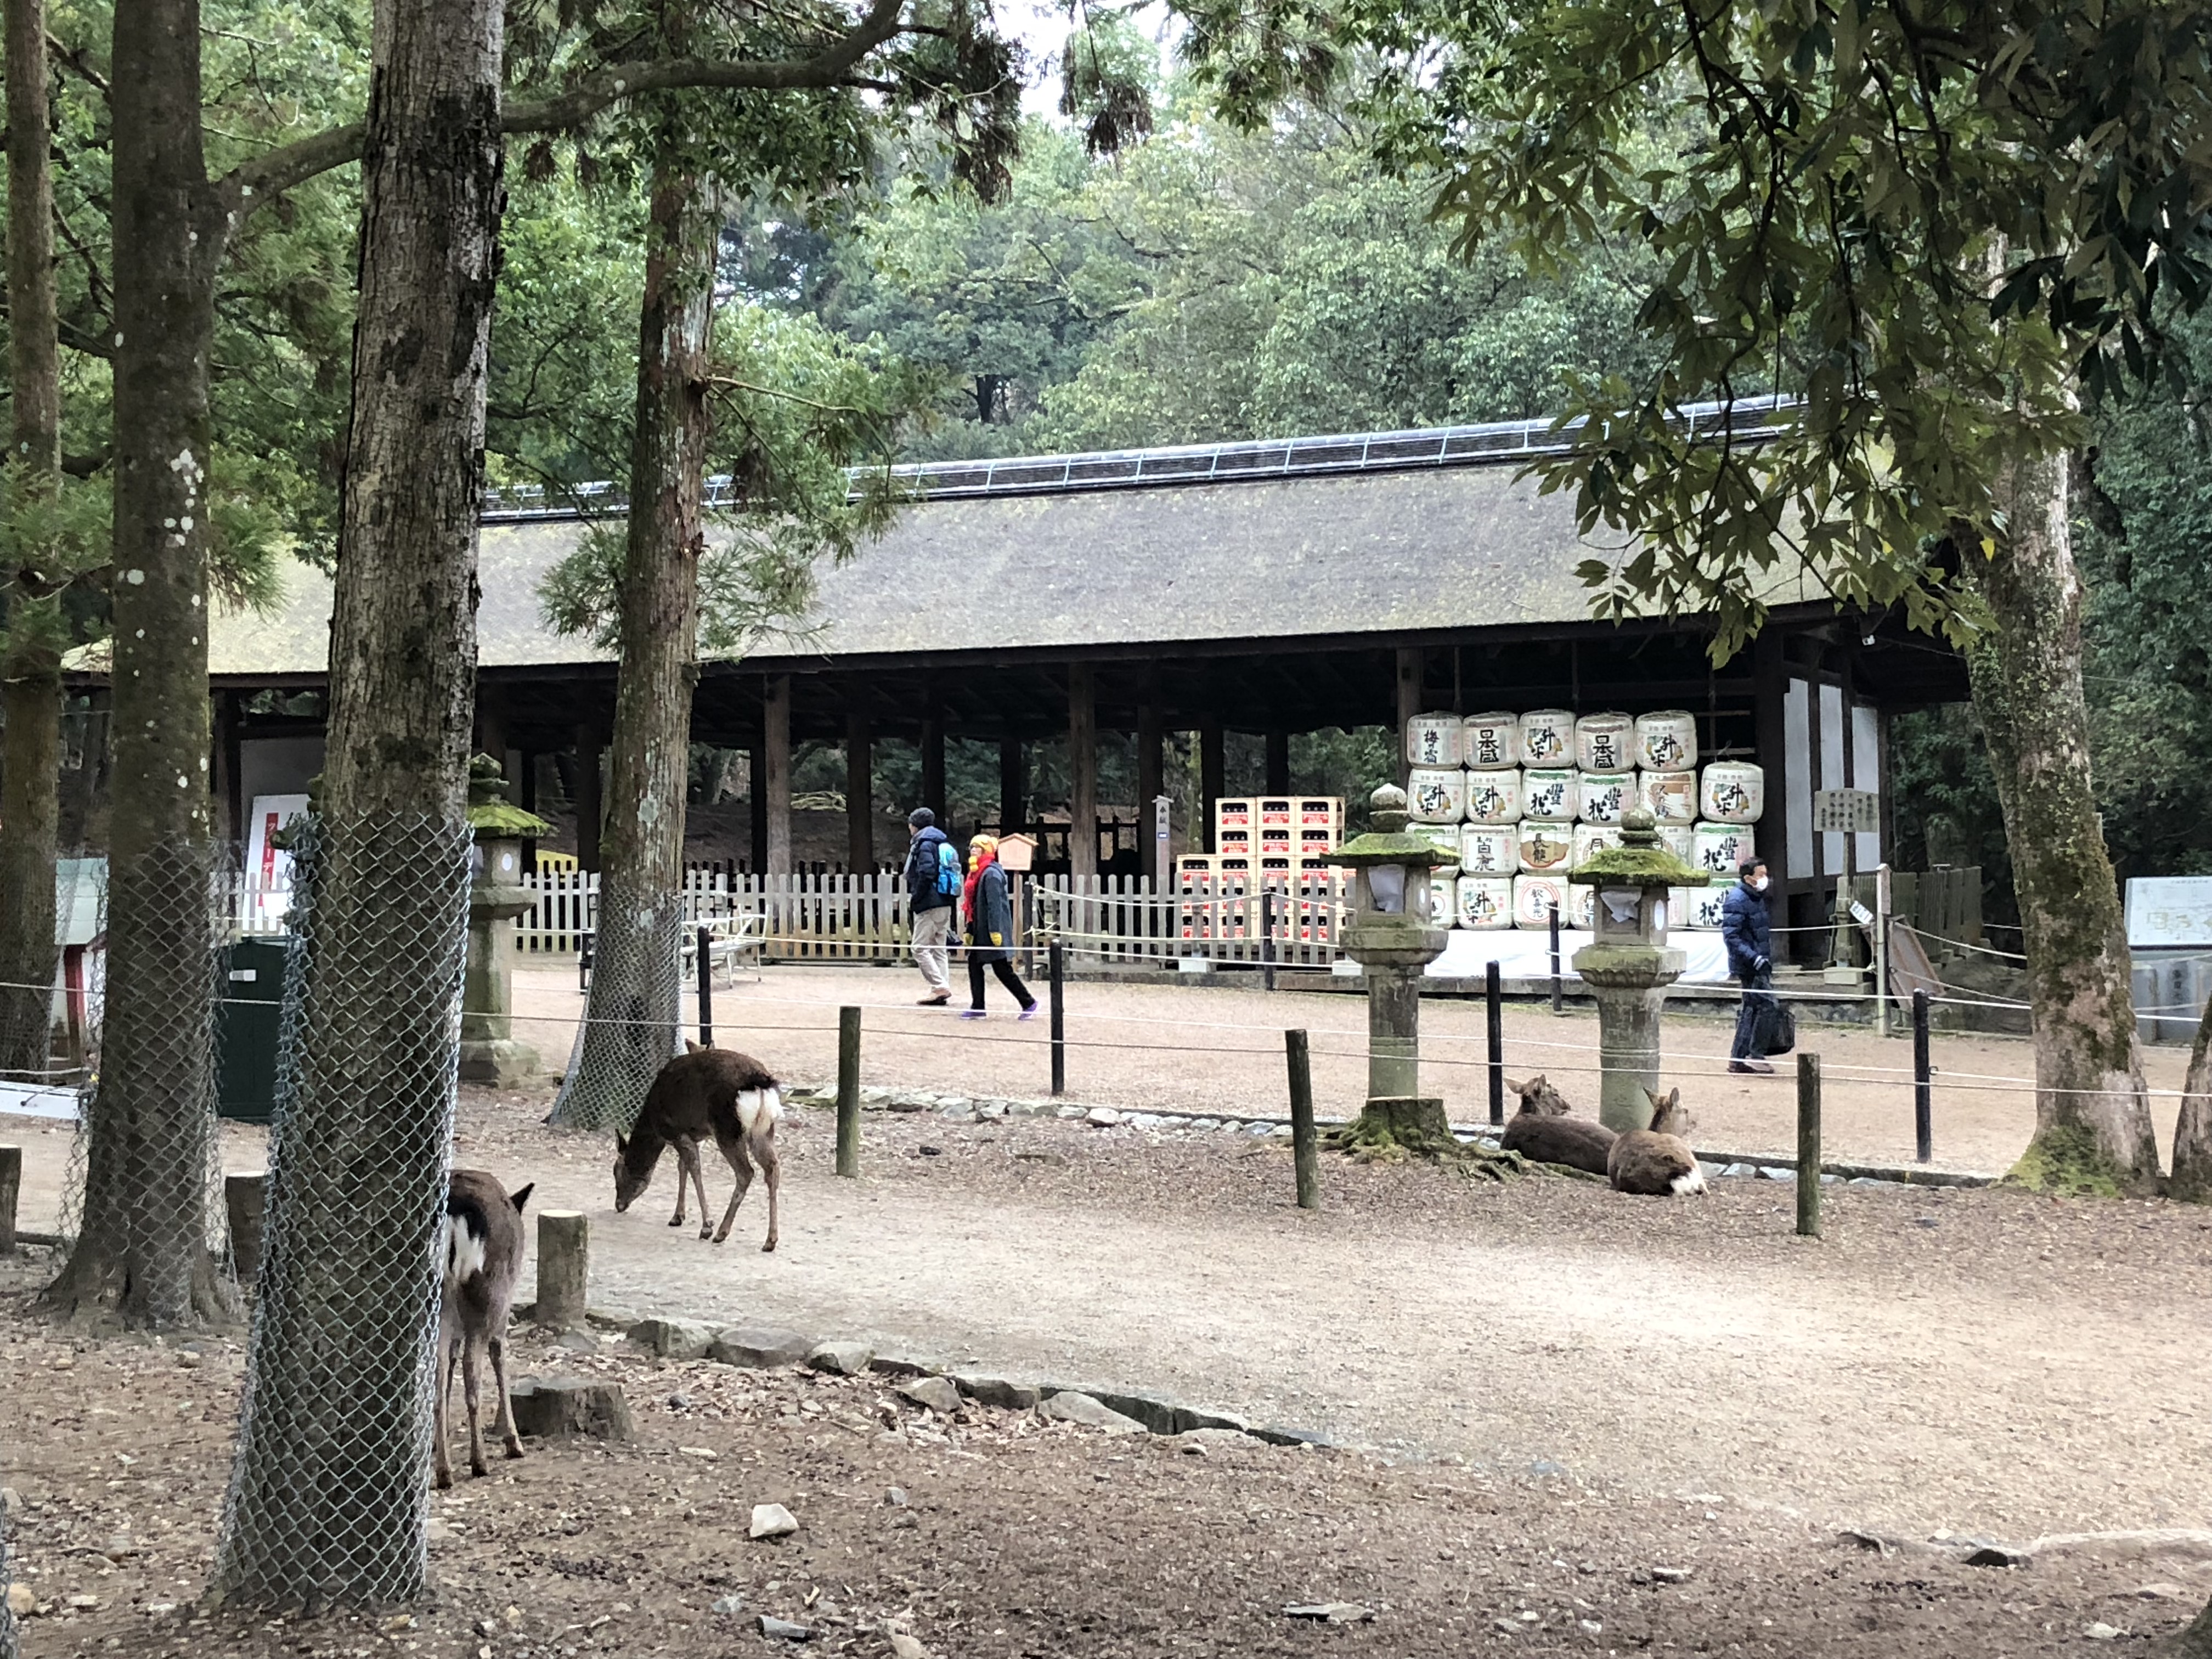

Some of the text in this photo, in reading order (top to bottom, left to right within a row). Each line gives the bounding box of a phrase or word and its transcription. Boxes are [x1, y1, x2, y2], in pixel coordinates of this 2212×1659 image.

[1478, 729, 1499, 764] 日本盛
[1593, 735, 1615, 768] 日本盛
